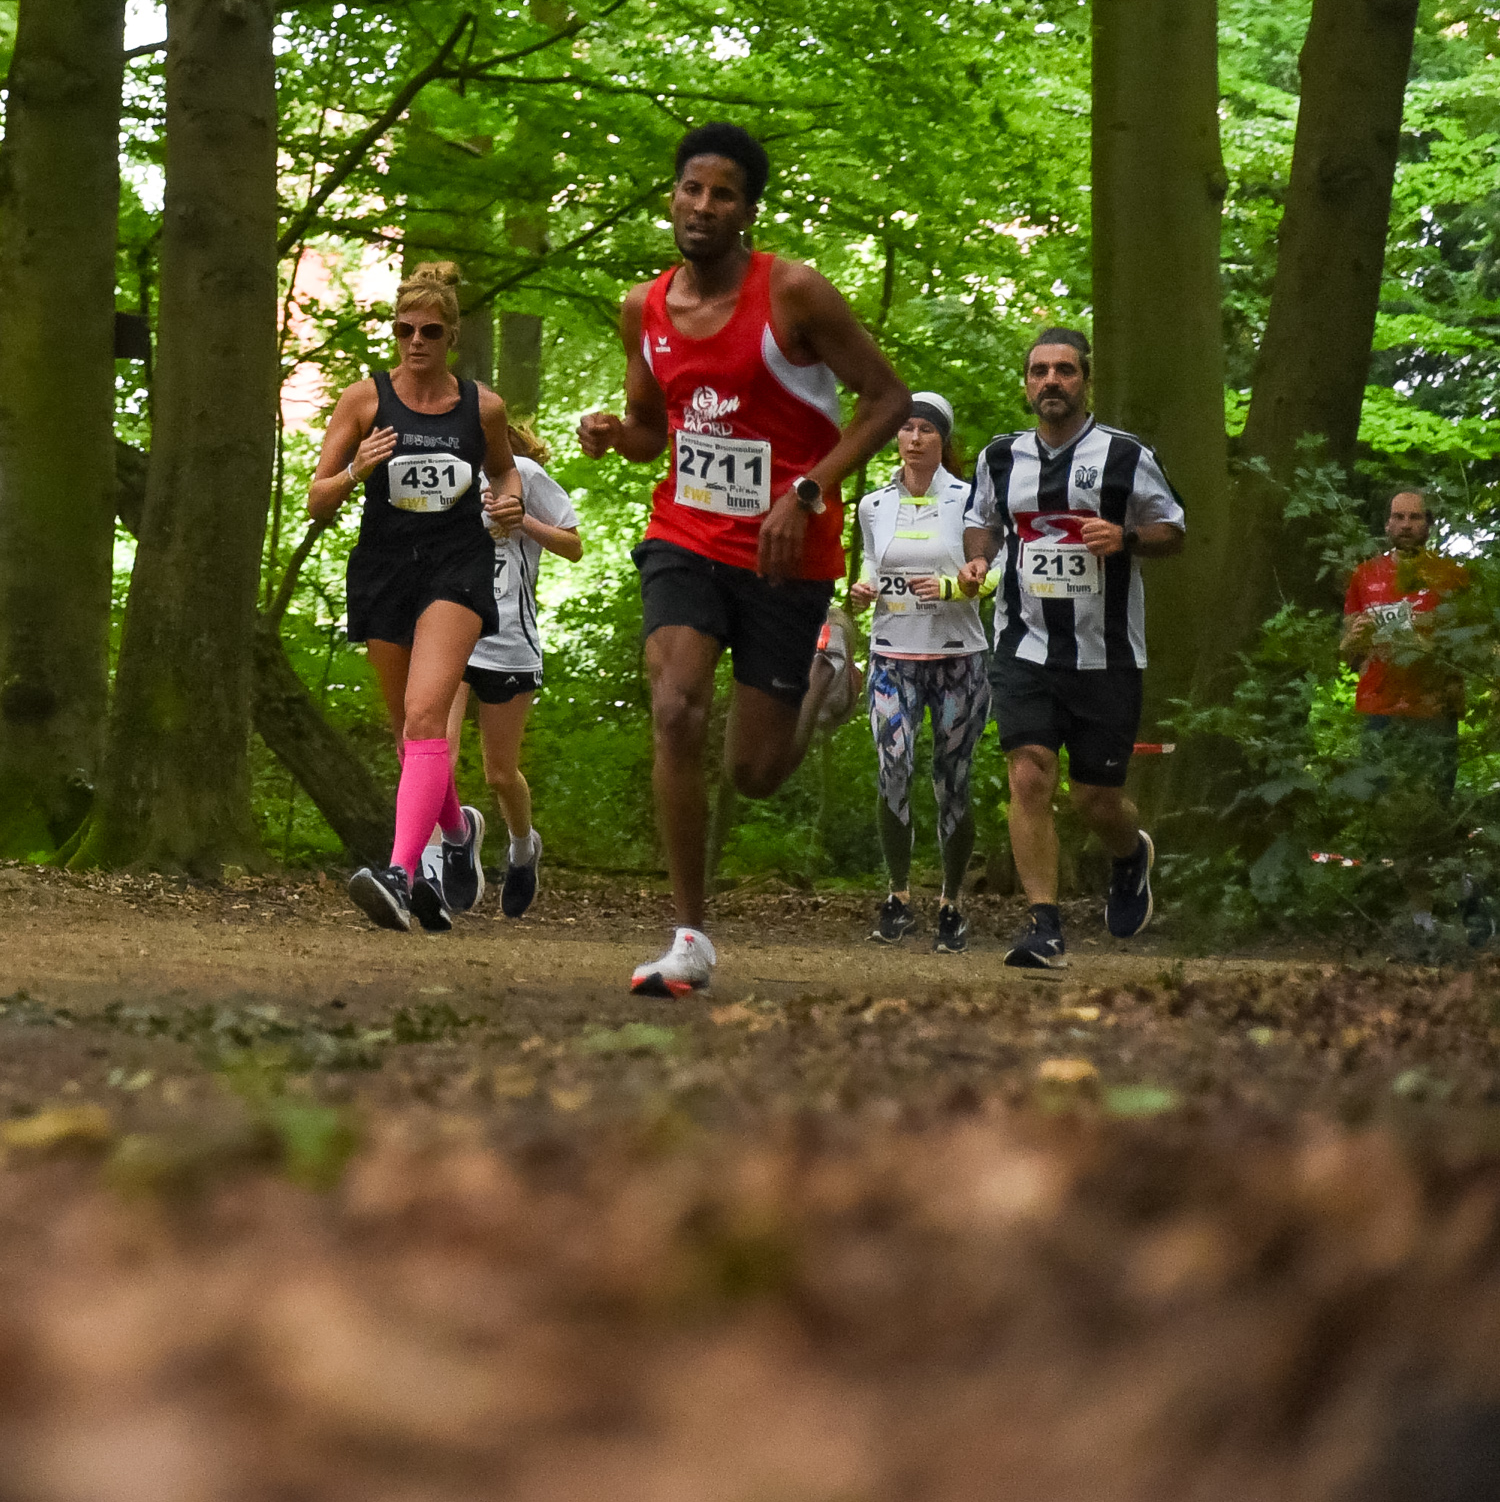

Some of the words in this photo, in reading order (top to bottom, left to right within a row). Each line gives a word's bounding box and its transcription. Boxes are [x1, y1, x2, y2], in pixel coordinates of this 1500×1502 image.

[401, 464, 456, 489] 431
[679, 444, 762, 486] 2711
[683, 484, 713, 505] EWE
[727, 492, 760, 509] bruns
[494, 559, 507, 578] 7
[1032, 554, 1086, 576] 213
